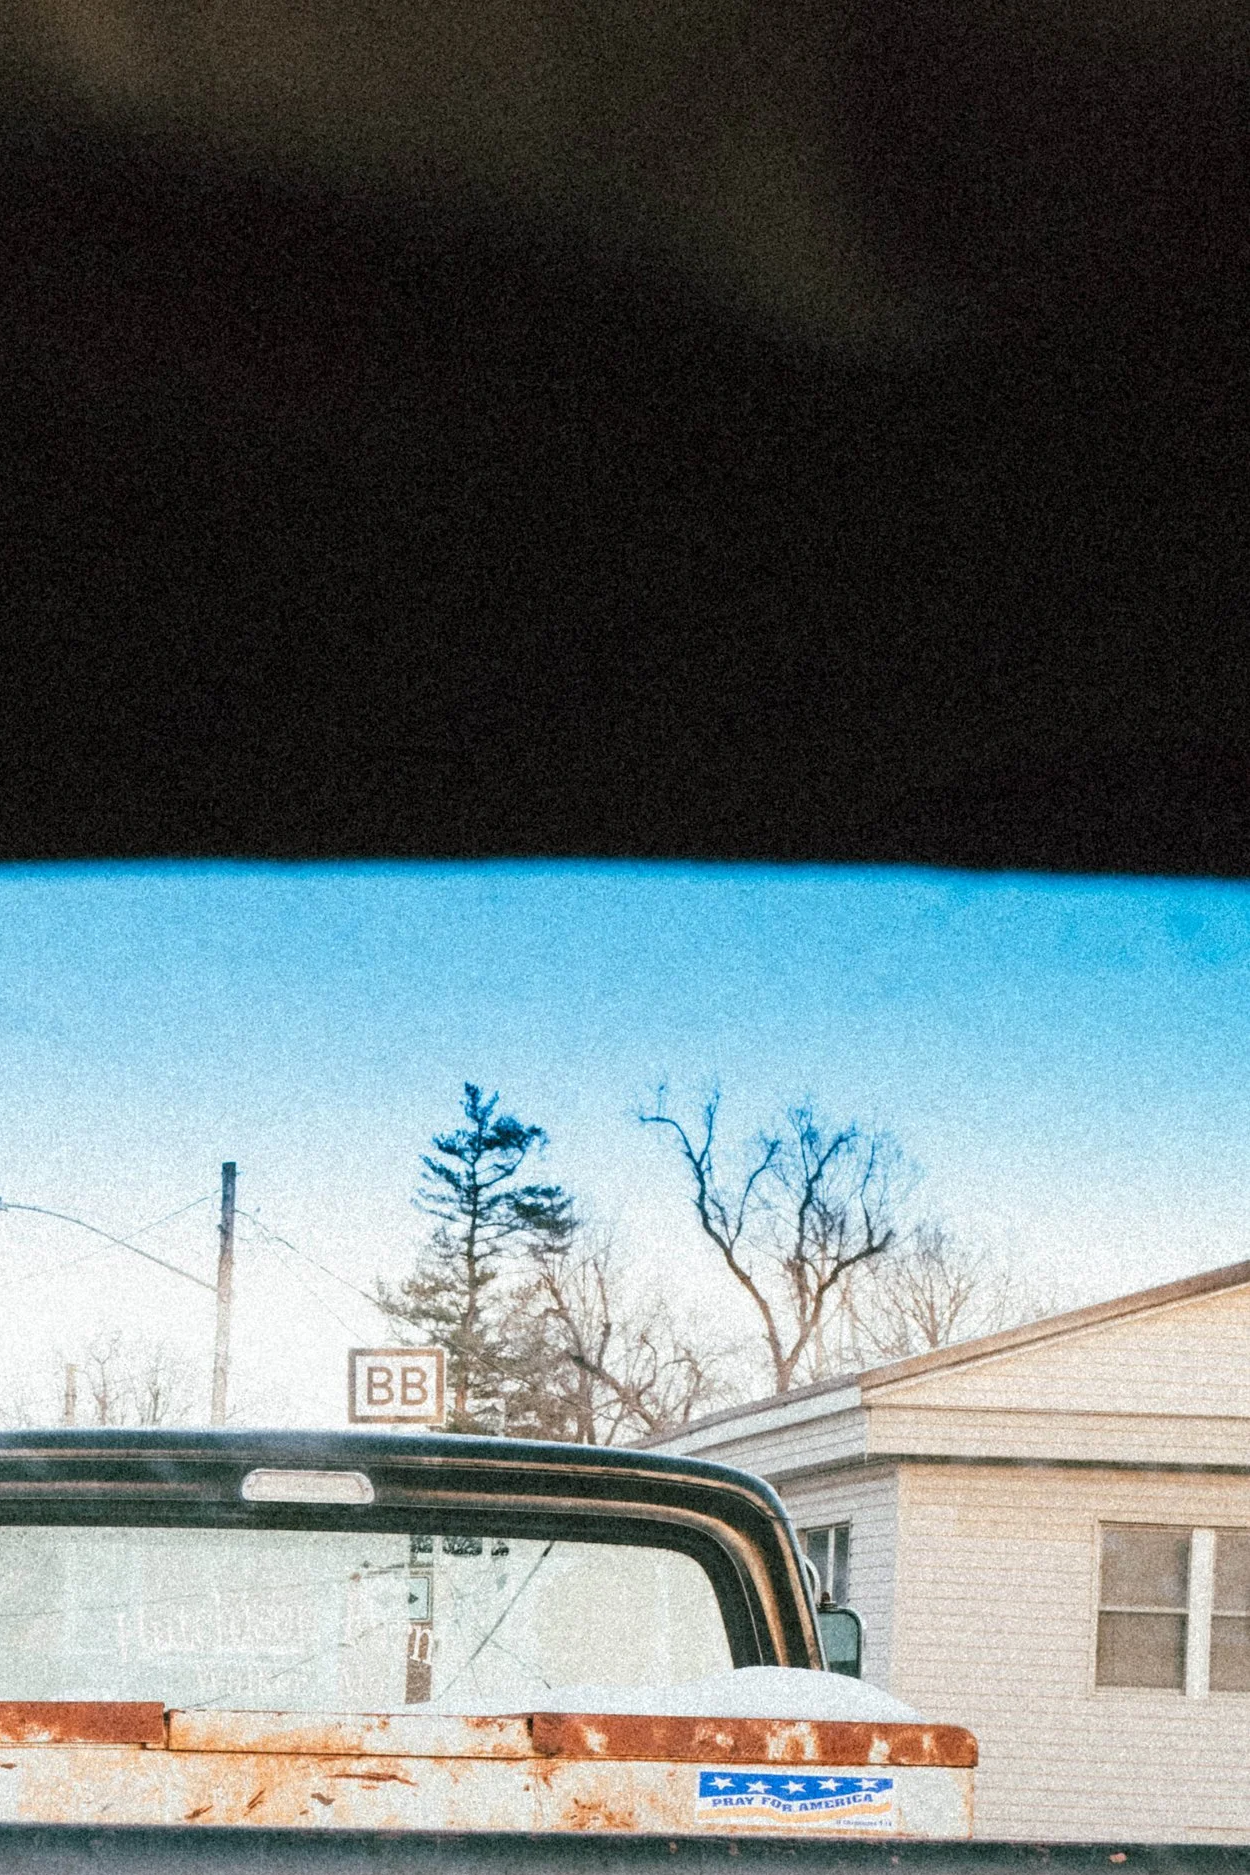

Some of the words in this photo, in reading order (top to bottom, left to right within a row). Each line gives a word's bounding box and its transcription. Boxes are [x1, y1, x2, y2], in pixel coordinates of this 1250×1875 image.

[367, 1366, 428, 1406] BB
[711, 1796, 755, 1808] PRAY
[761, 1796, 794, 1813] FOR
[799, 1792, 874, 1812] AMERICA
